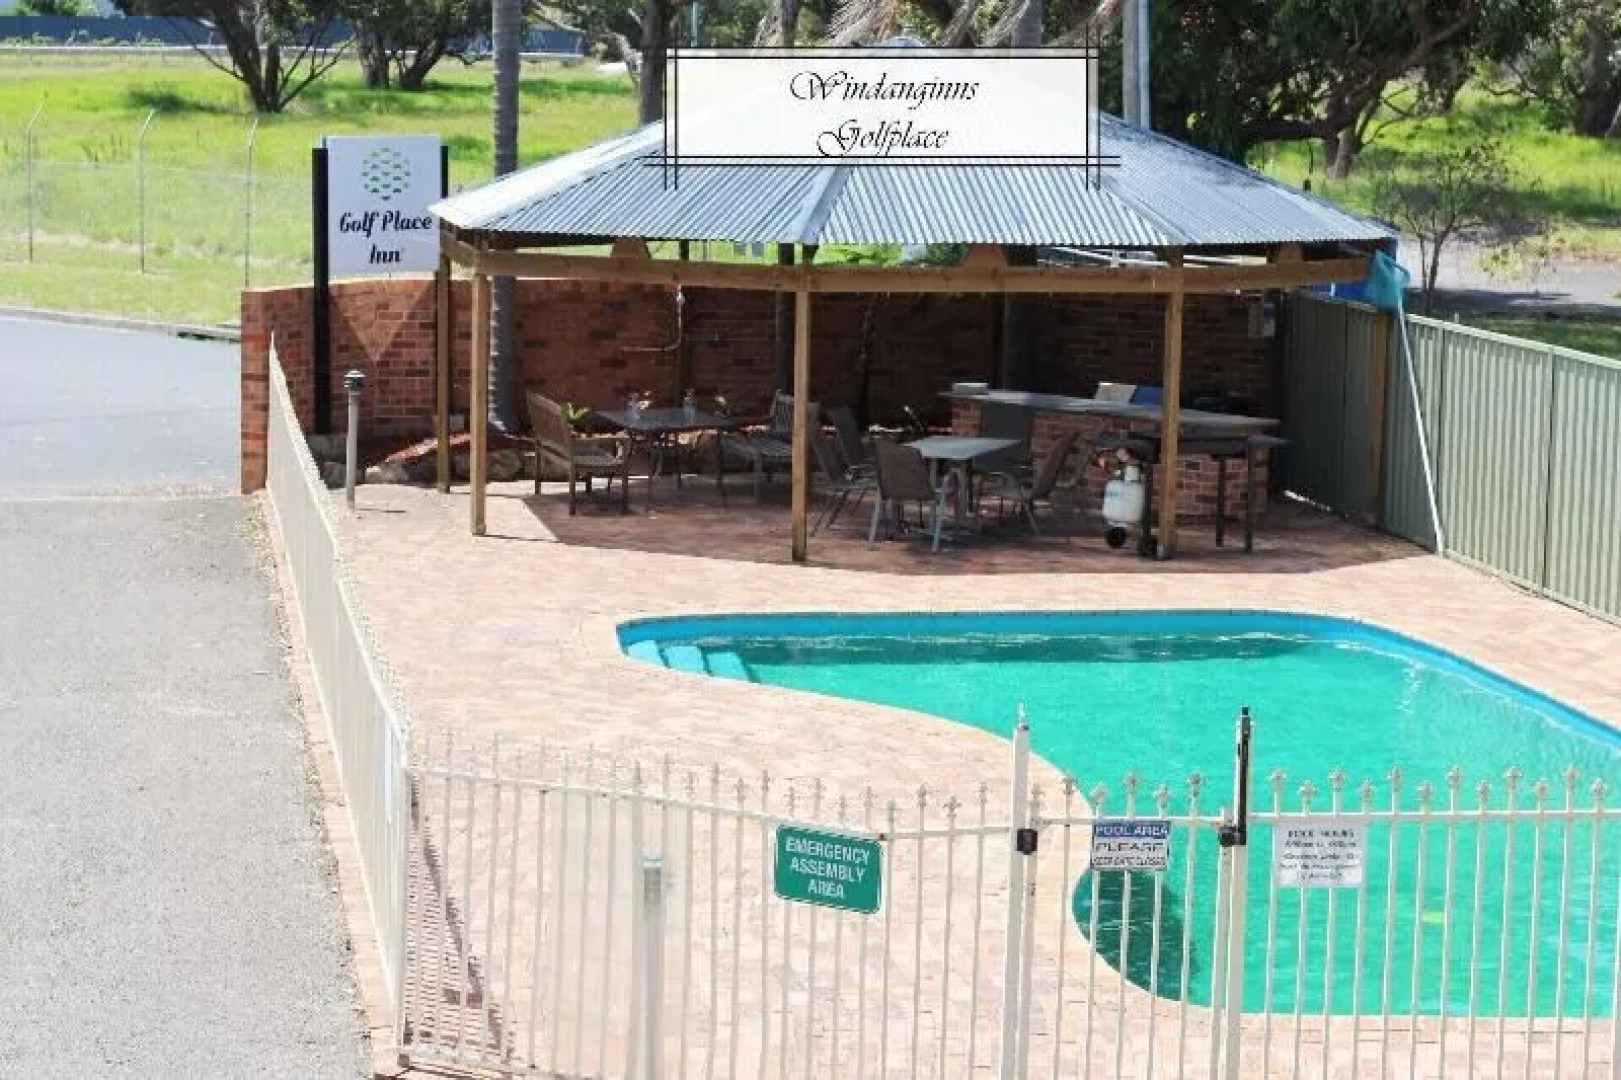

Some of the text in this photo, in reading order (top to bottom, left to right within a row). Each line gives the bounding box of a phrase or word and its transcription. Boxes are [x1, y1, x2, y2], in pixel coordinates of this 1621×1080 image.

[340, 210, 432, 237] Golf Place
[369, 243, 401, 263] Inn
[1096, 826, 1168, 836] POOL AREA
[786, 836, 870, 865] EMERGENCY
[1096, 842, 1166, 853] PLEASE
[790, 856, 866, 882] ASSEMBLY
[808, 879, 845, 898] AREA
